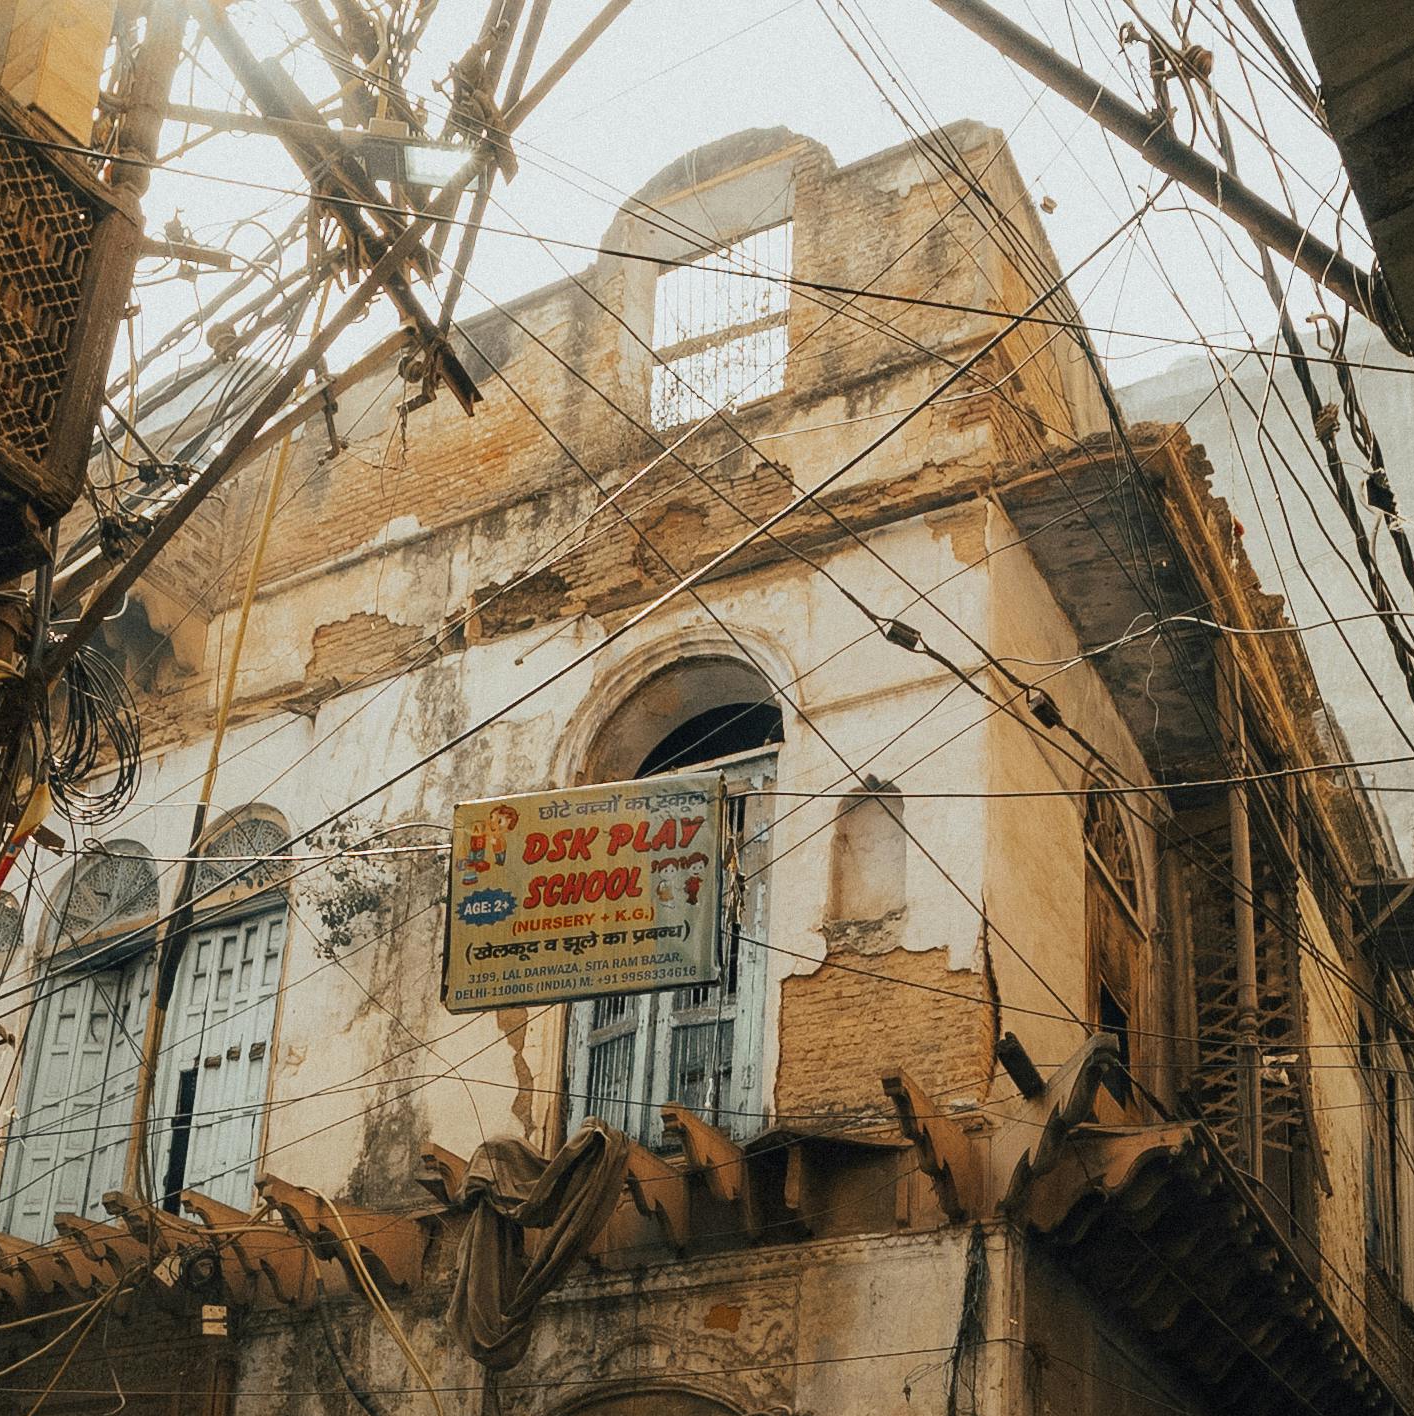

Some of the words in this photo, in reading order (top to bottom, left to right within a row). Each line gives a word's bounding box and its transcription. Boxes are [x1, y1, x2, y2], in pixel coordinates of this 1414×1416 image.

[539, 801, 571, 820] छोटे
[522, 827, 599, 864] DSK
[606, 816, 705, 856] PLAY
[523, 866, 643, 909] SCHOOL
[464, 901, 491, 915] AGE:
[494, 900, 509, 912] 2+
[512, 913, 595, 936] (NURSERY
[601, 913, 609, 922] +
[615, 907, 654, 922] K.G.)
[544, 939, 559, 951] व
[603, 931, 627, 945] का
[503, 968, 521, 980] LAL
[585, 960, 609, 971] SITA
[612, 956, 638, 968] RAM
[641, 952, 683, 965] BAZAR,
[537, 979, 576, 993] (INDIA)
[580, 977, 593, 987] M:
[598, 975, 618, 984] +91
